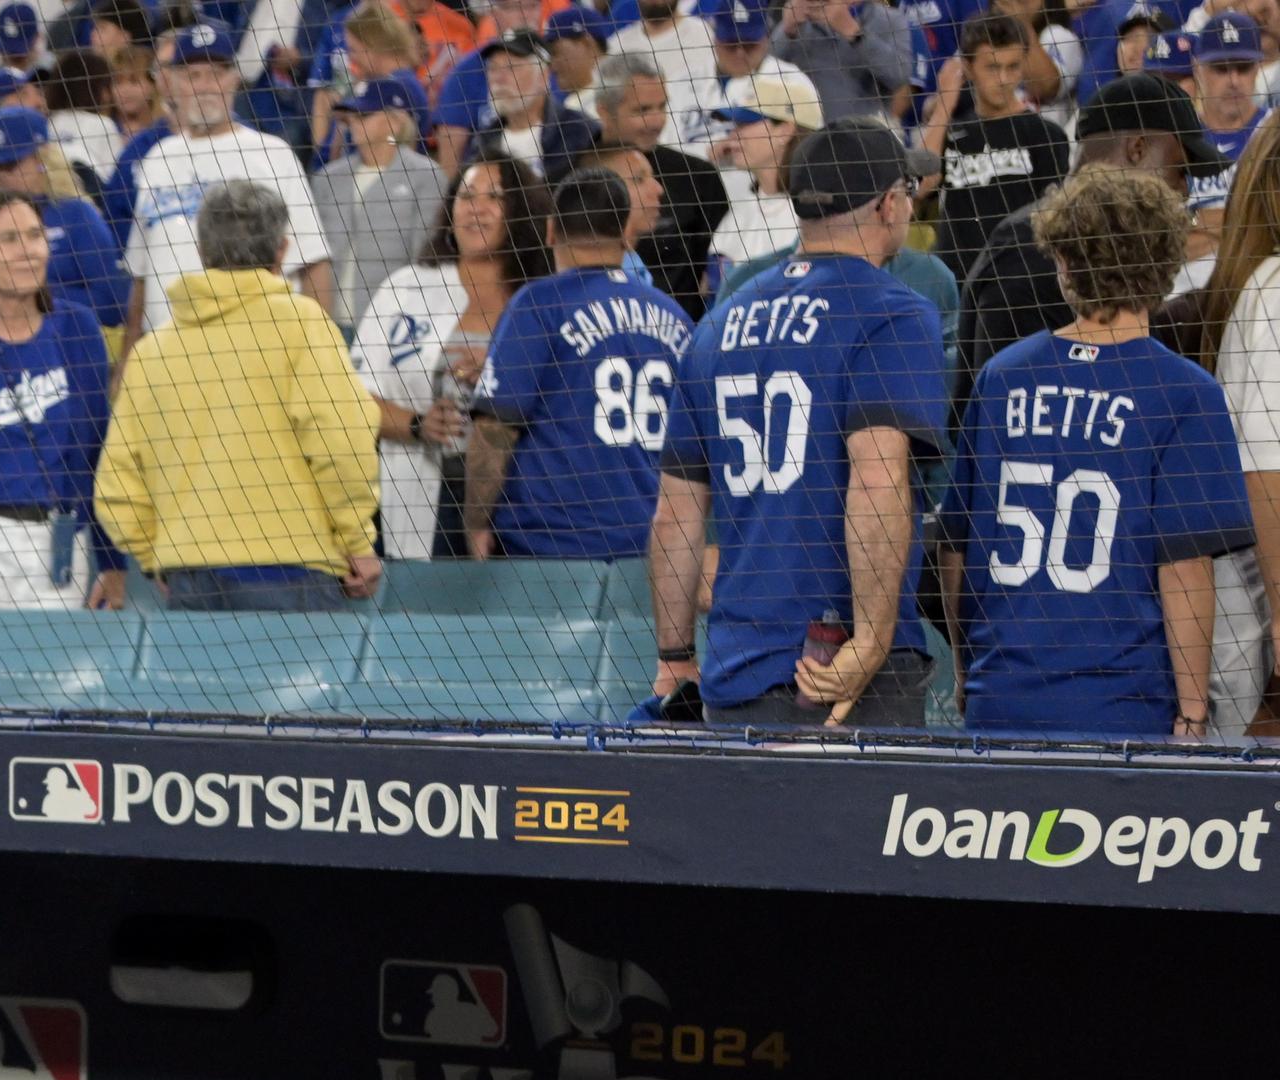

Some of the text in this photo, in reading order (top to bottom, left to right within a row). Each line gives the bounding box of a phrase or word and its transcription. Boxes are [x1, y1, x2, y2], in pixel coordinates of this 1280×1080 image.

[559, 300, 614, 357] SAN
[721, 295, 830, 351] BETTS
[593, 357, 674, 451] 86
[715, 371, 813, 497] 50
[1006, 385, 1135, 447] BETTS
[989, 461, 1121, 594] 50
[112, 762, 630, 841] POSTSEASON 2024
[881, 792, 1271, 884] loanDepot
[630, 1022, 791, 1070] 2024
